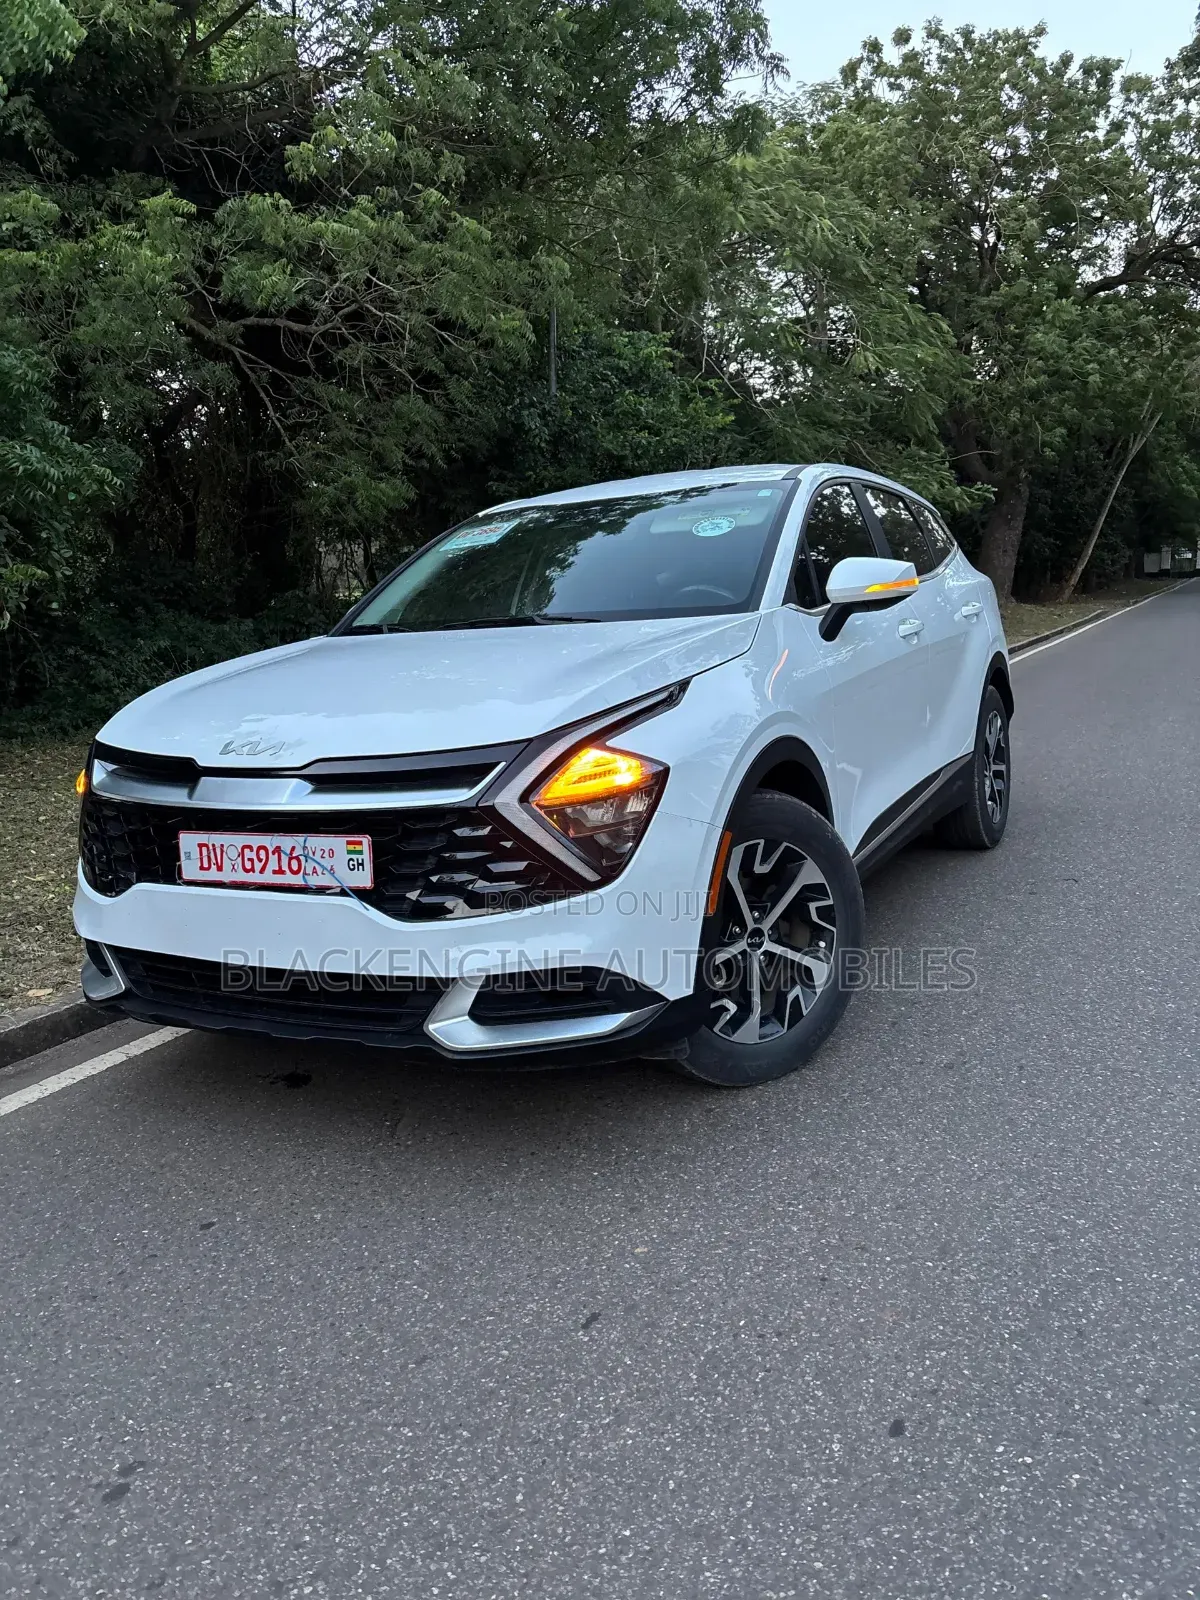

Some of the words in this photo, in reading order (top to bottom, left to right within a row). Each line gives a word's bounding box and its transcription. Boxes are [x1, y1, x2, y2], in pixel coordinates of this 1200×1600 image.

[219, 740, 286, 756] KIA
[197, 843, 225, 872] DV
[347, 857, 366, 872] GH
